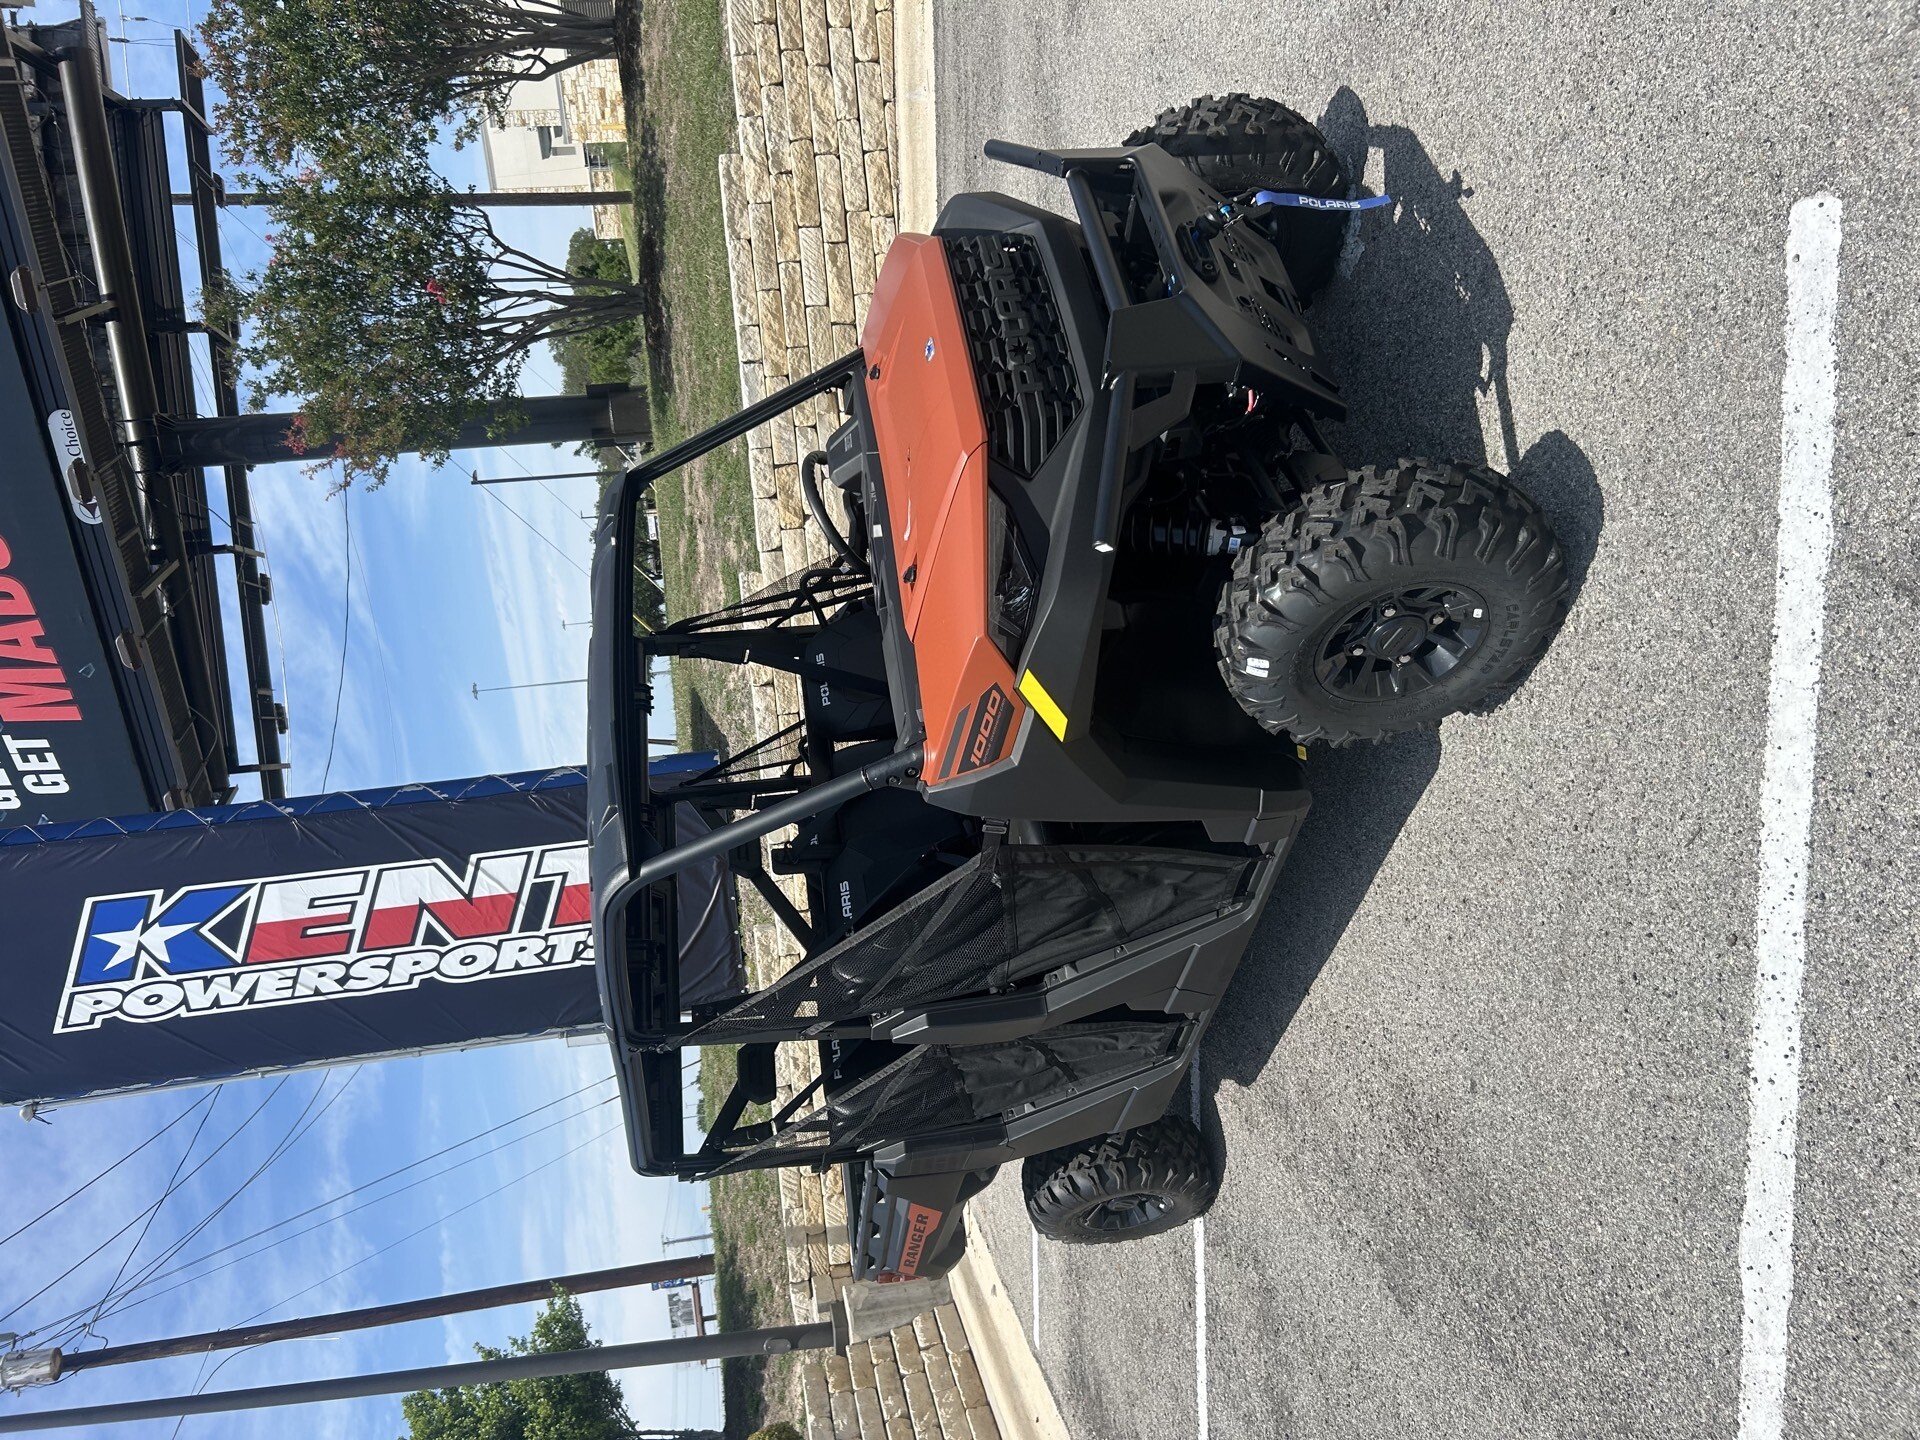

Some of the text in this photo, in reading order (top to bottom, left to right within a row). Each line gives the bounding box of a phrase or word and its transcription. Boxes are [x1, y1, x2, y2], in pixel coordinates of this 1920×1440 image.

[1298, 196, 1361, 209] POLARIS
[977, 236, 1044, 393] POLARIS
[60, 411, 82, 457] Choice
[815, 652, 831, 707] POLIS
[970, 689, 1001, 766] 1000
[1, 734, 70, 794] GET
[903, 1213, 929, 1268] RANGER
